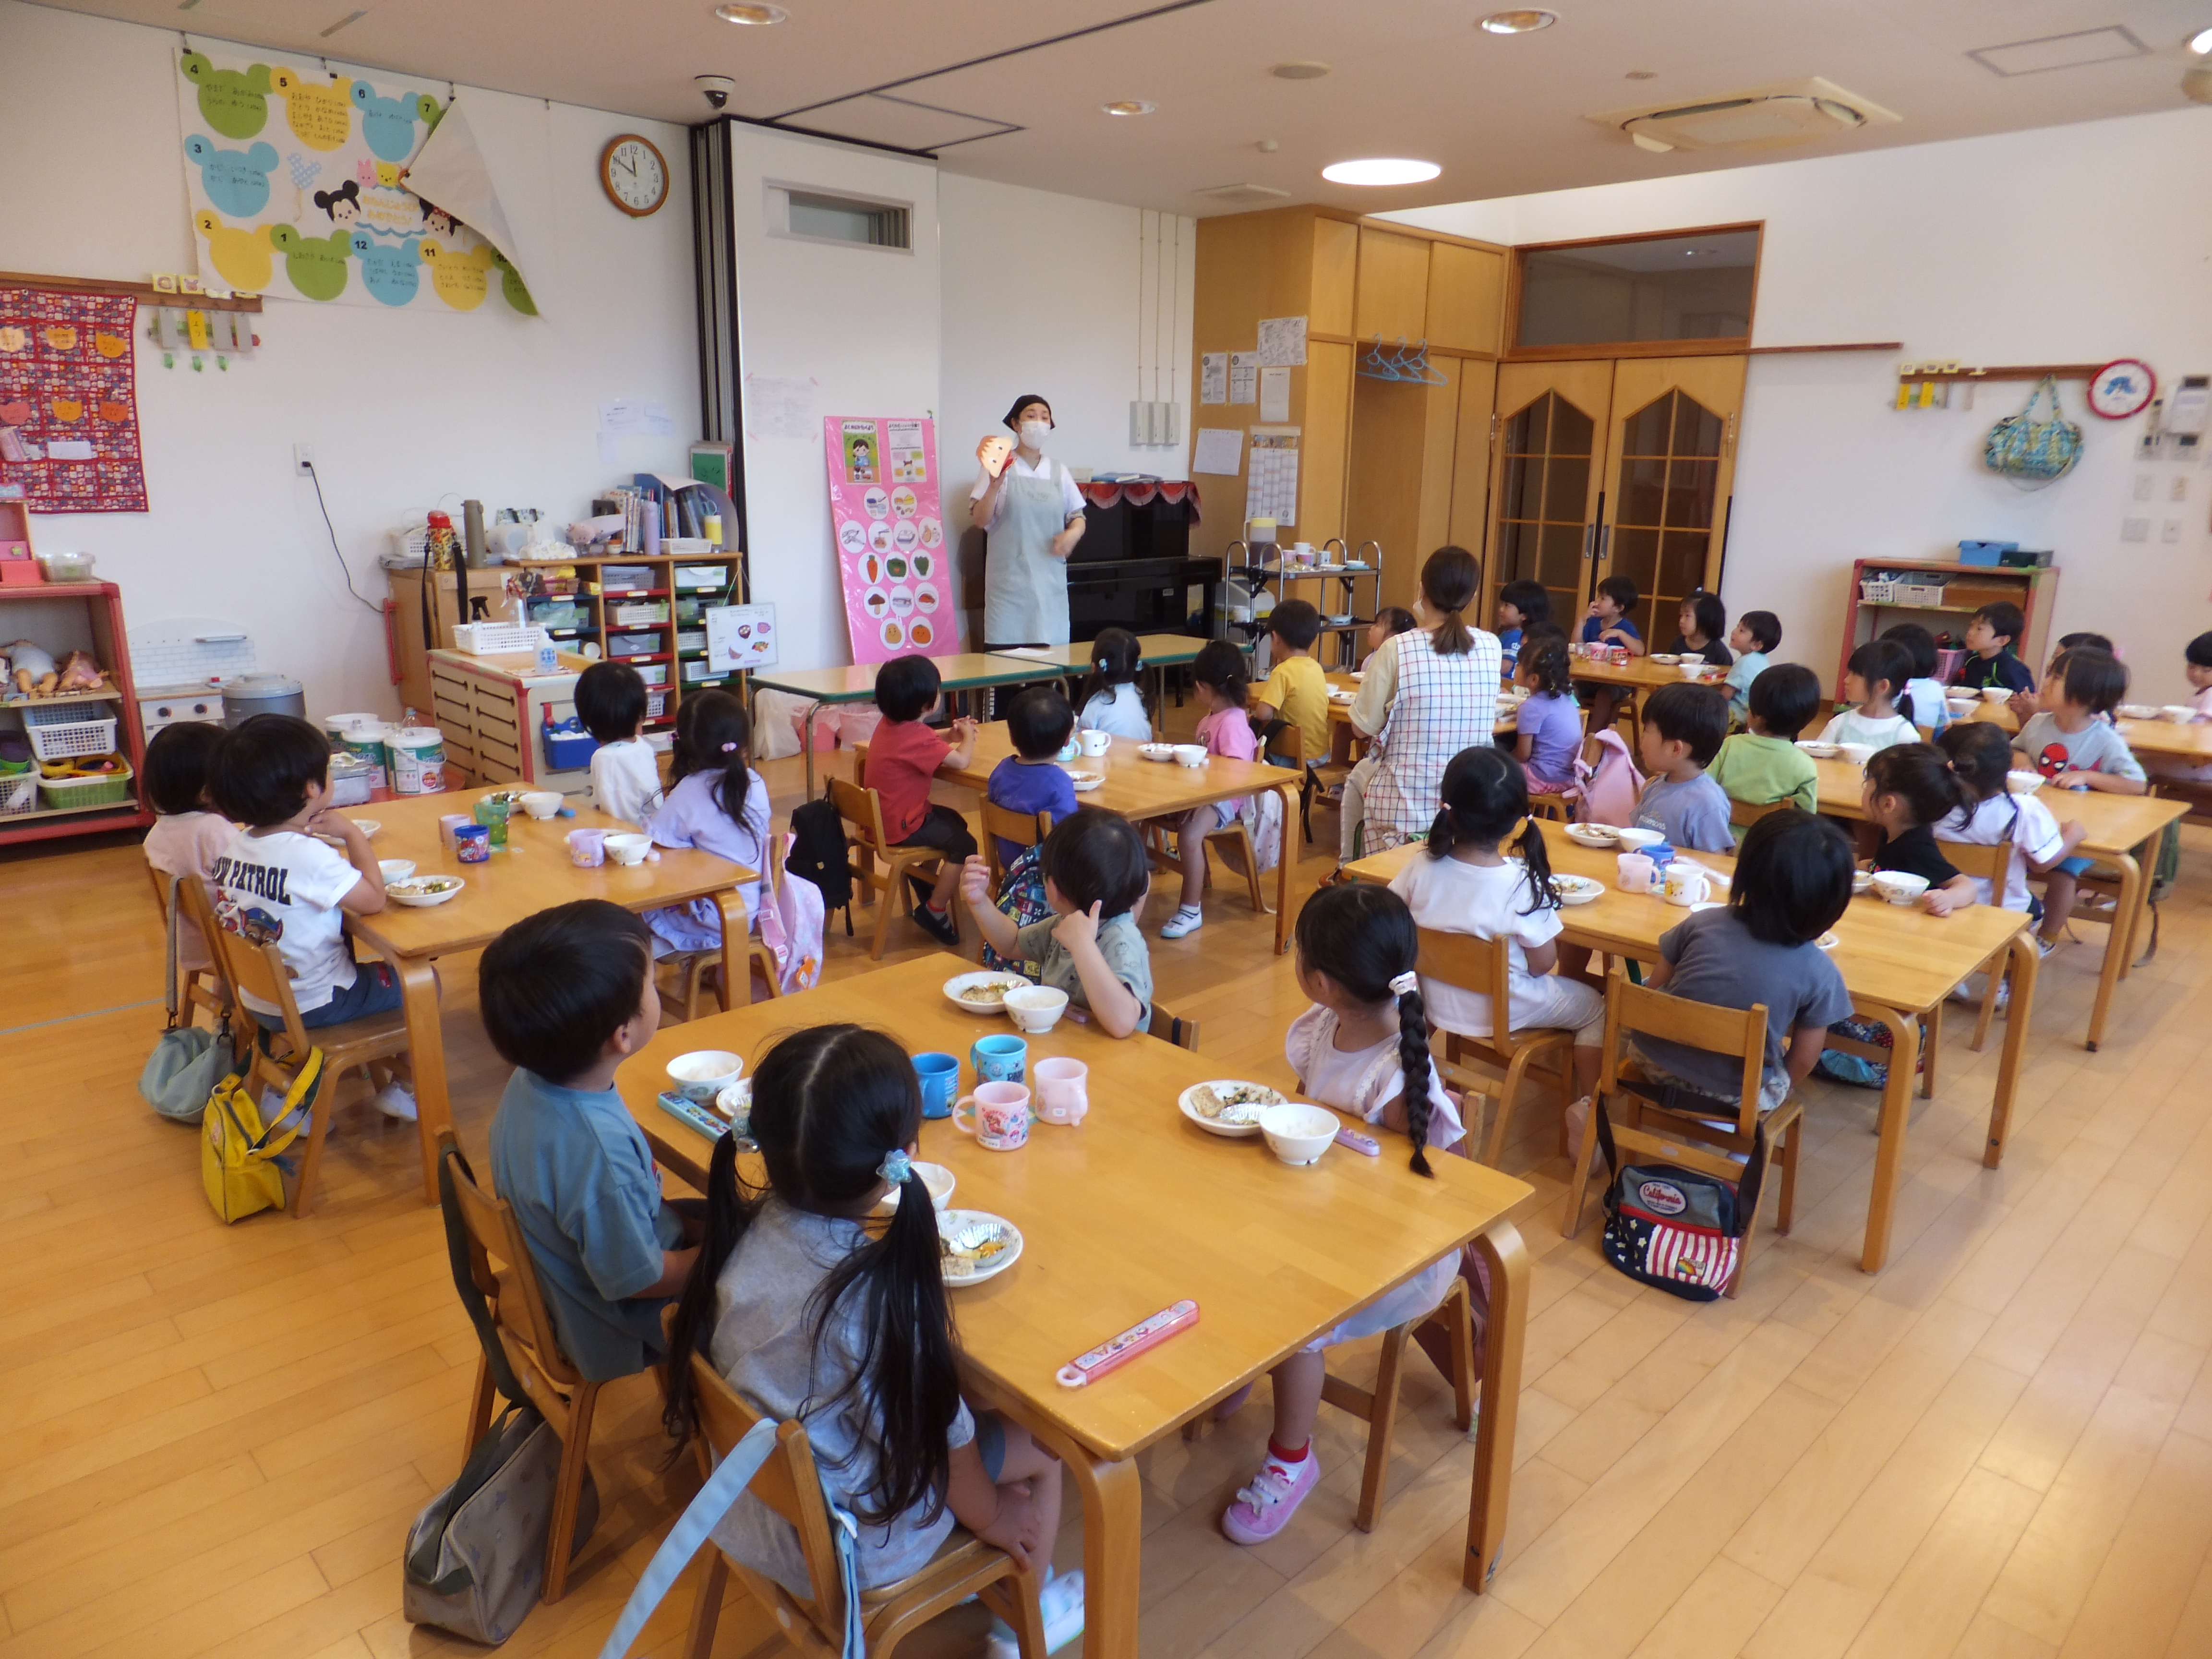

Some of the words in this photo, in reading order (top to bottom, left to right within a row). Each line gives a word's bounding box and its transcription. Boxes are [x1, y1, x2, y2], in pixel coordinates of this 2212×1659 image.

[190, 64, 199, 74] 4
[280, 77, 288, 87] 5
[424, 103, 430, 112] 7
[194, 144, 202, 154] 3
[621, 148, 626, 156] 11
[630, 144, 638, 155] 12
[643, 150, 646, 159] 1
[650, 160, 655, 170] 2
[611, 168, 616, 178] 9
[654, 173, 658, 183] 3
[615, 181, 620, 192] 8
[651, 186, 656, 195] 4
[624, 192, 628, 202] 7
[634, 196, 639, 206] 6
[644, 195, 649, 204] 5
[204, 220, 212, 229] 2
[280, 233, 287, 241] 1
[355, 240, 367, 250] 12
[424, 249, 436, 257] 11
[229, 860, 291, 906] PATROL
